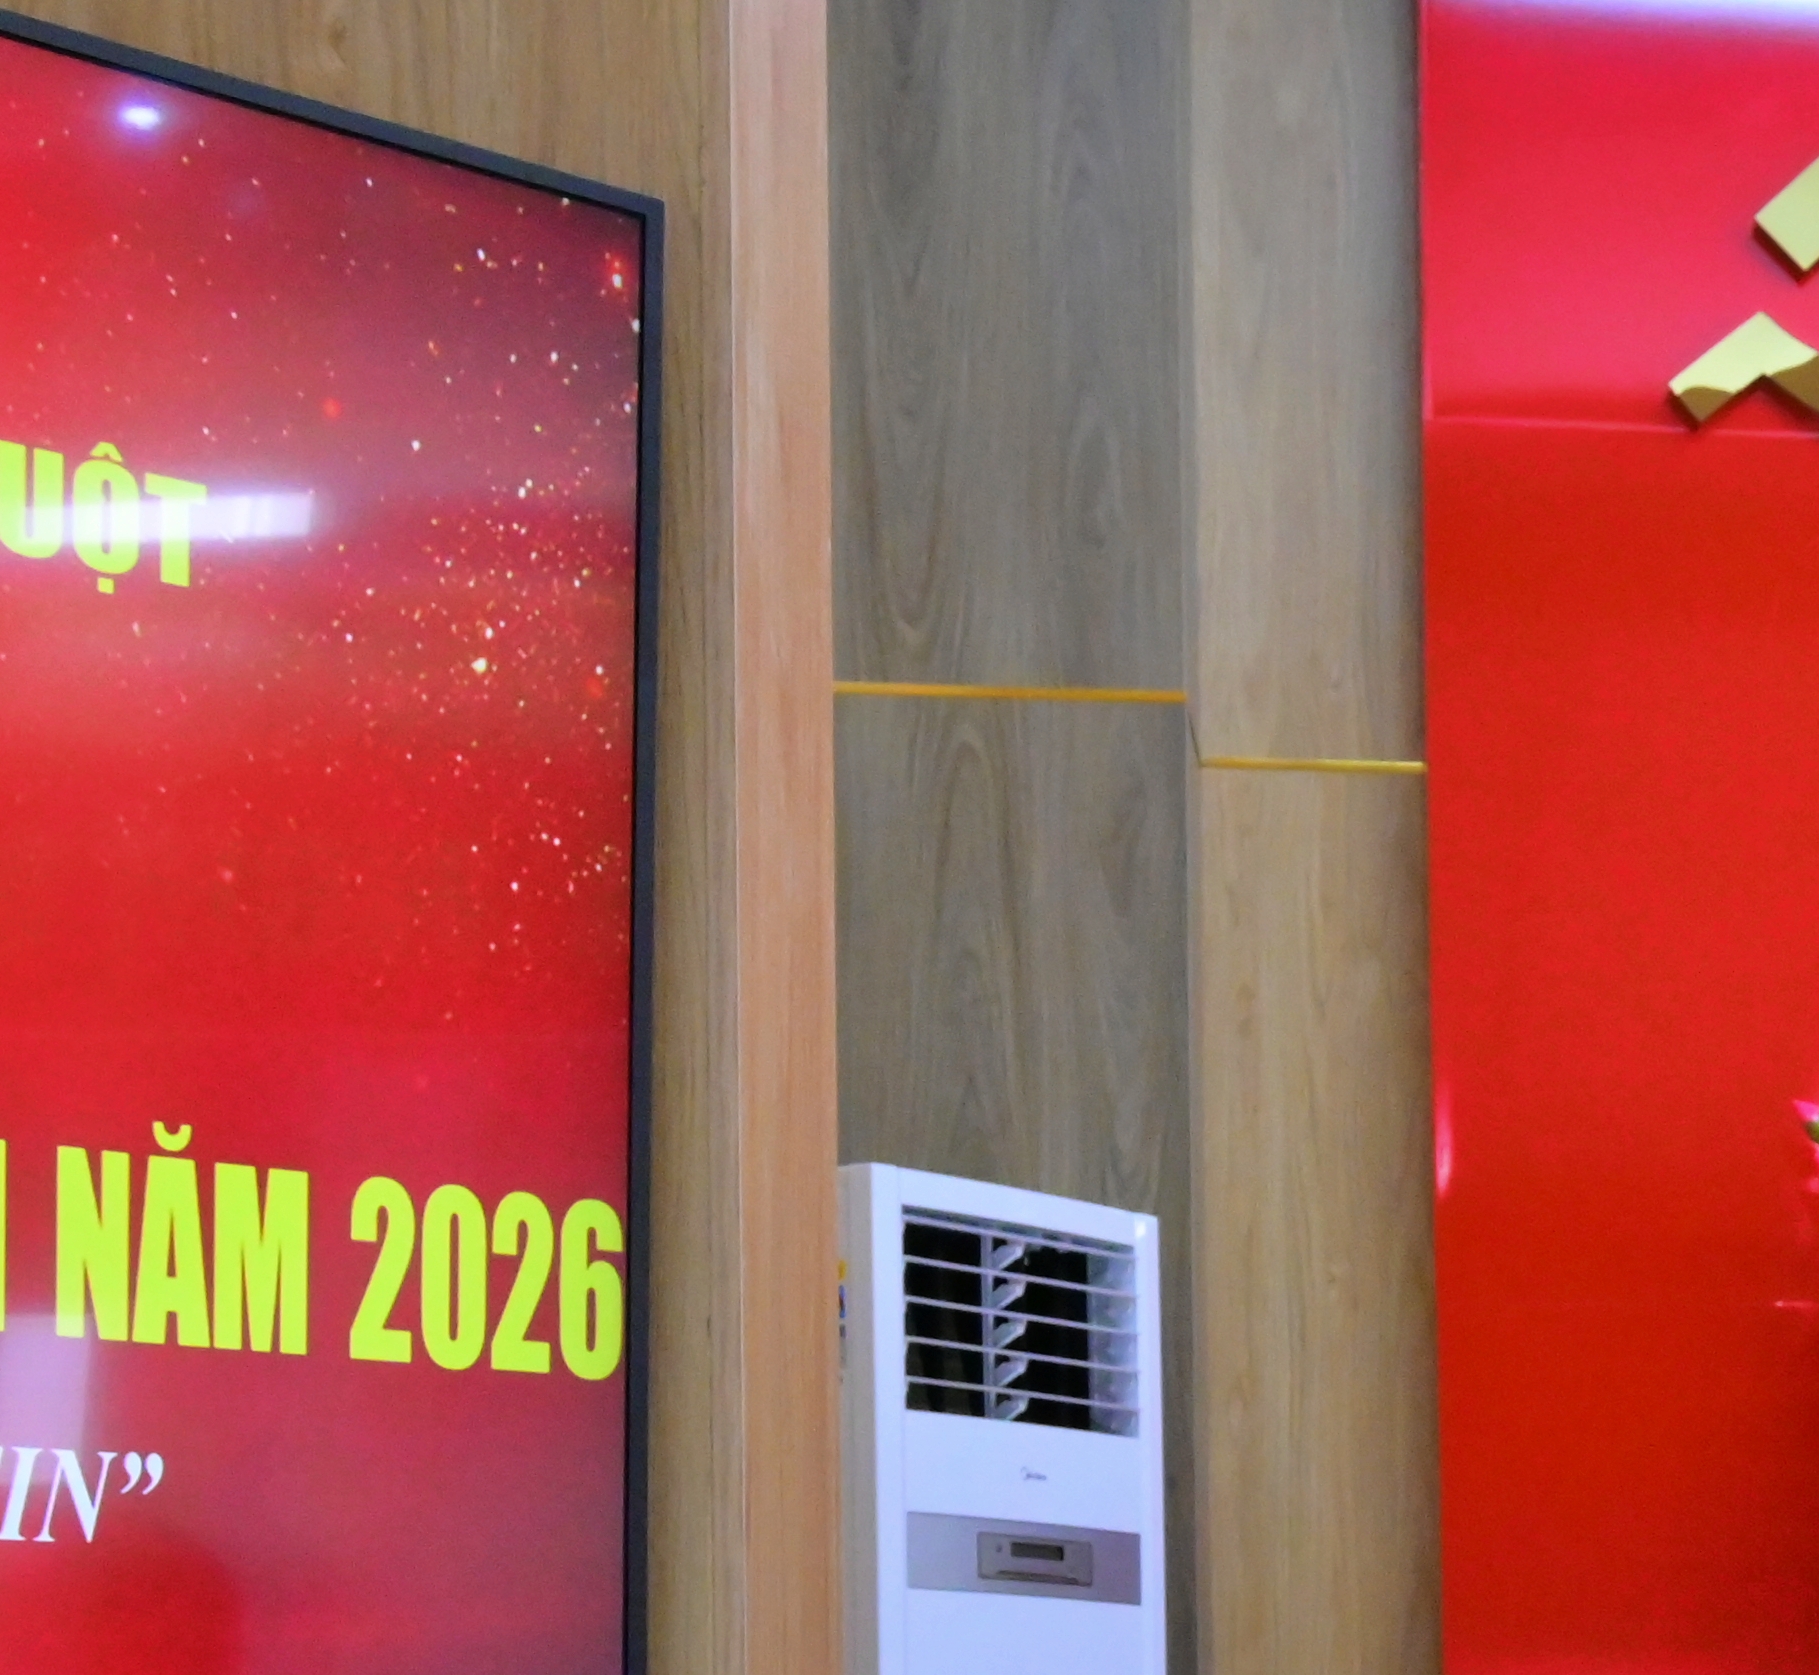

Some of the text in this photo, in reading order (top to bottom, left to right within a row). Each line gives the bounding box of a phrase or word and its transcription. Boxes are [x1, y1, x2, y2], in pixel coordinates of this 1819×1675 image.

[55, 1119, 310, 1357] NĂM
[348, 1174, 625, 1382] 2026
[0, 1444, 166, 1545] IN”
